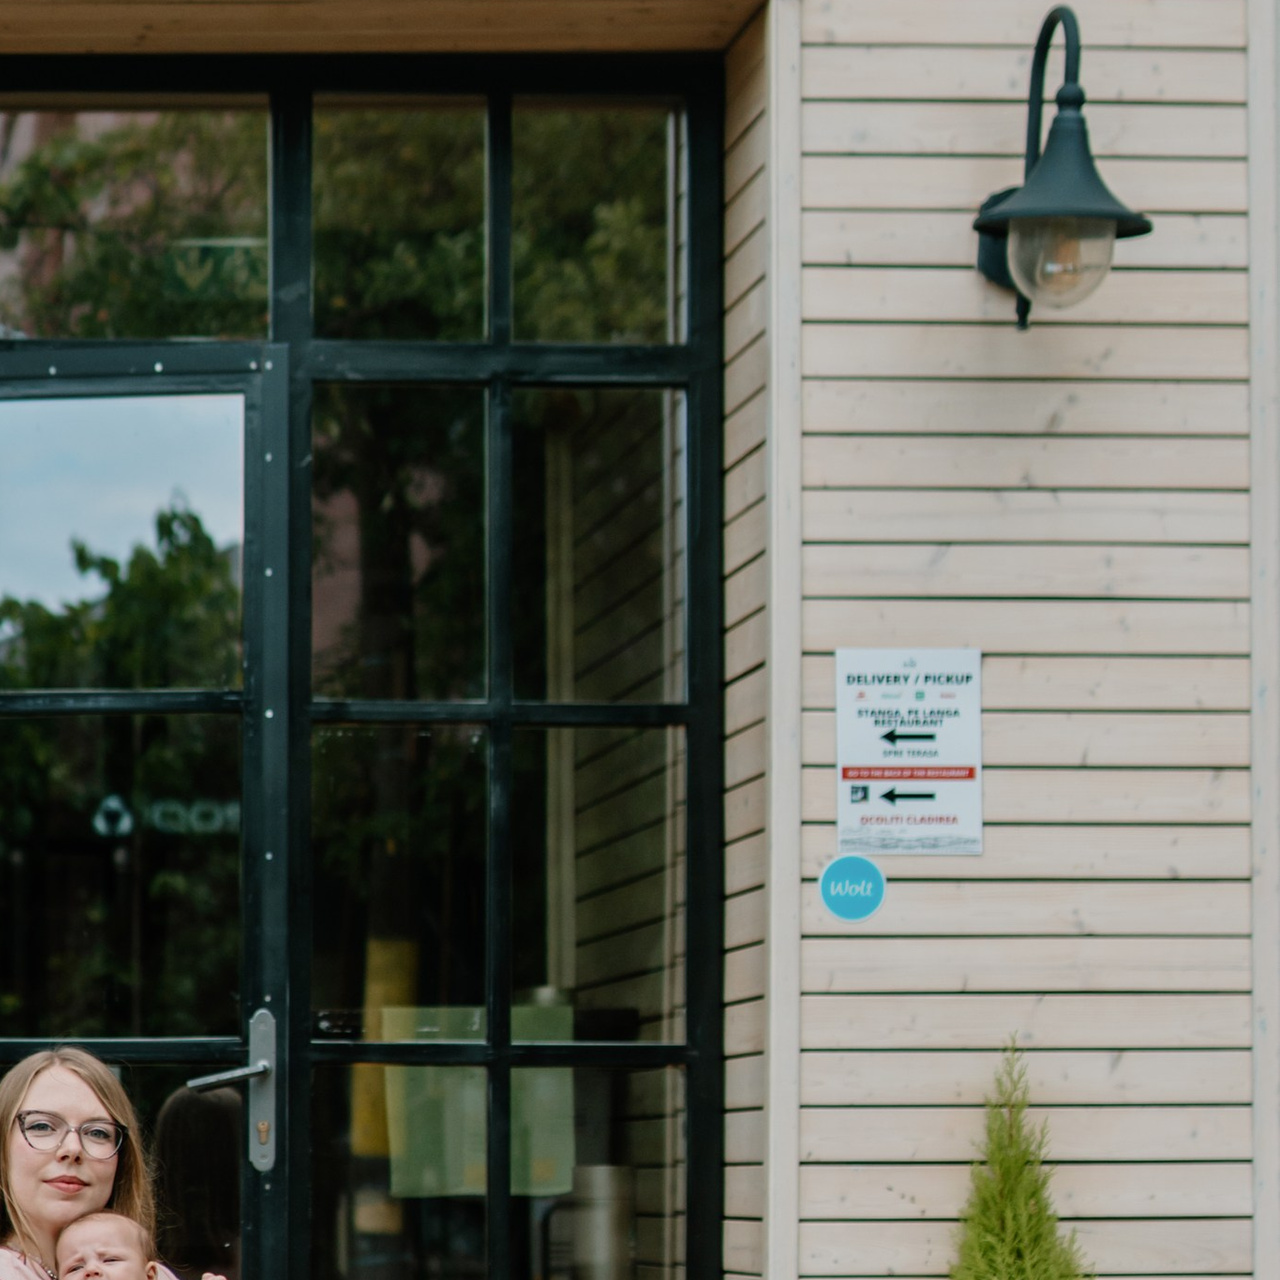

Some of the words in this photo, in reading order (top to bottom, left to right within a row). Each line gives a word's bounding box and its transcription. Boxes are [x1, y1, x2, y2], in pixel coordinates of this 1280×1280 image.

[846, 673, 910, 686] DELIVERY
[914, 673, 921, 686] /
[924, 673, 974, 686] PICKUP
[874, 718, 944, 728] RESTAURANT
[882, 749, 904, 758] SPRE
[907, 749, 939, 758] TERASA
[830, 879, 873, 897] Wolt
